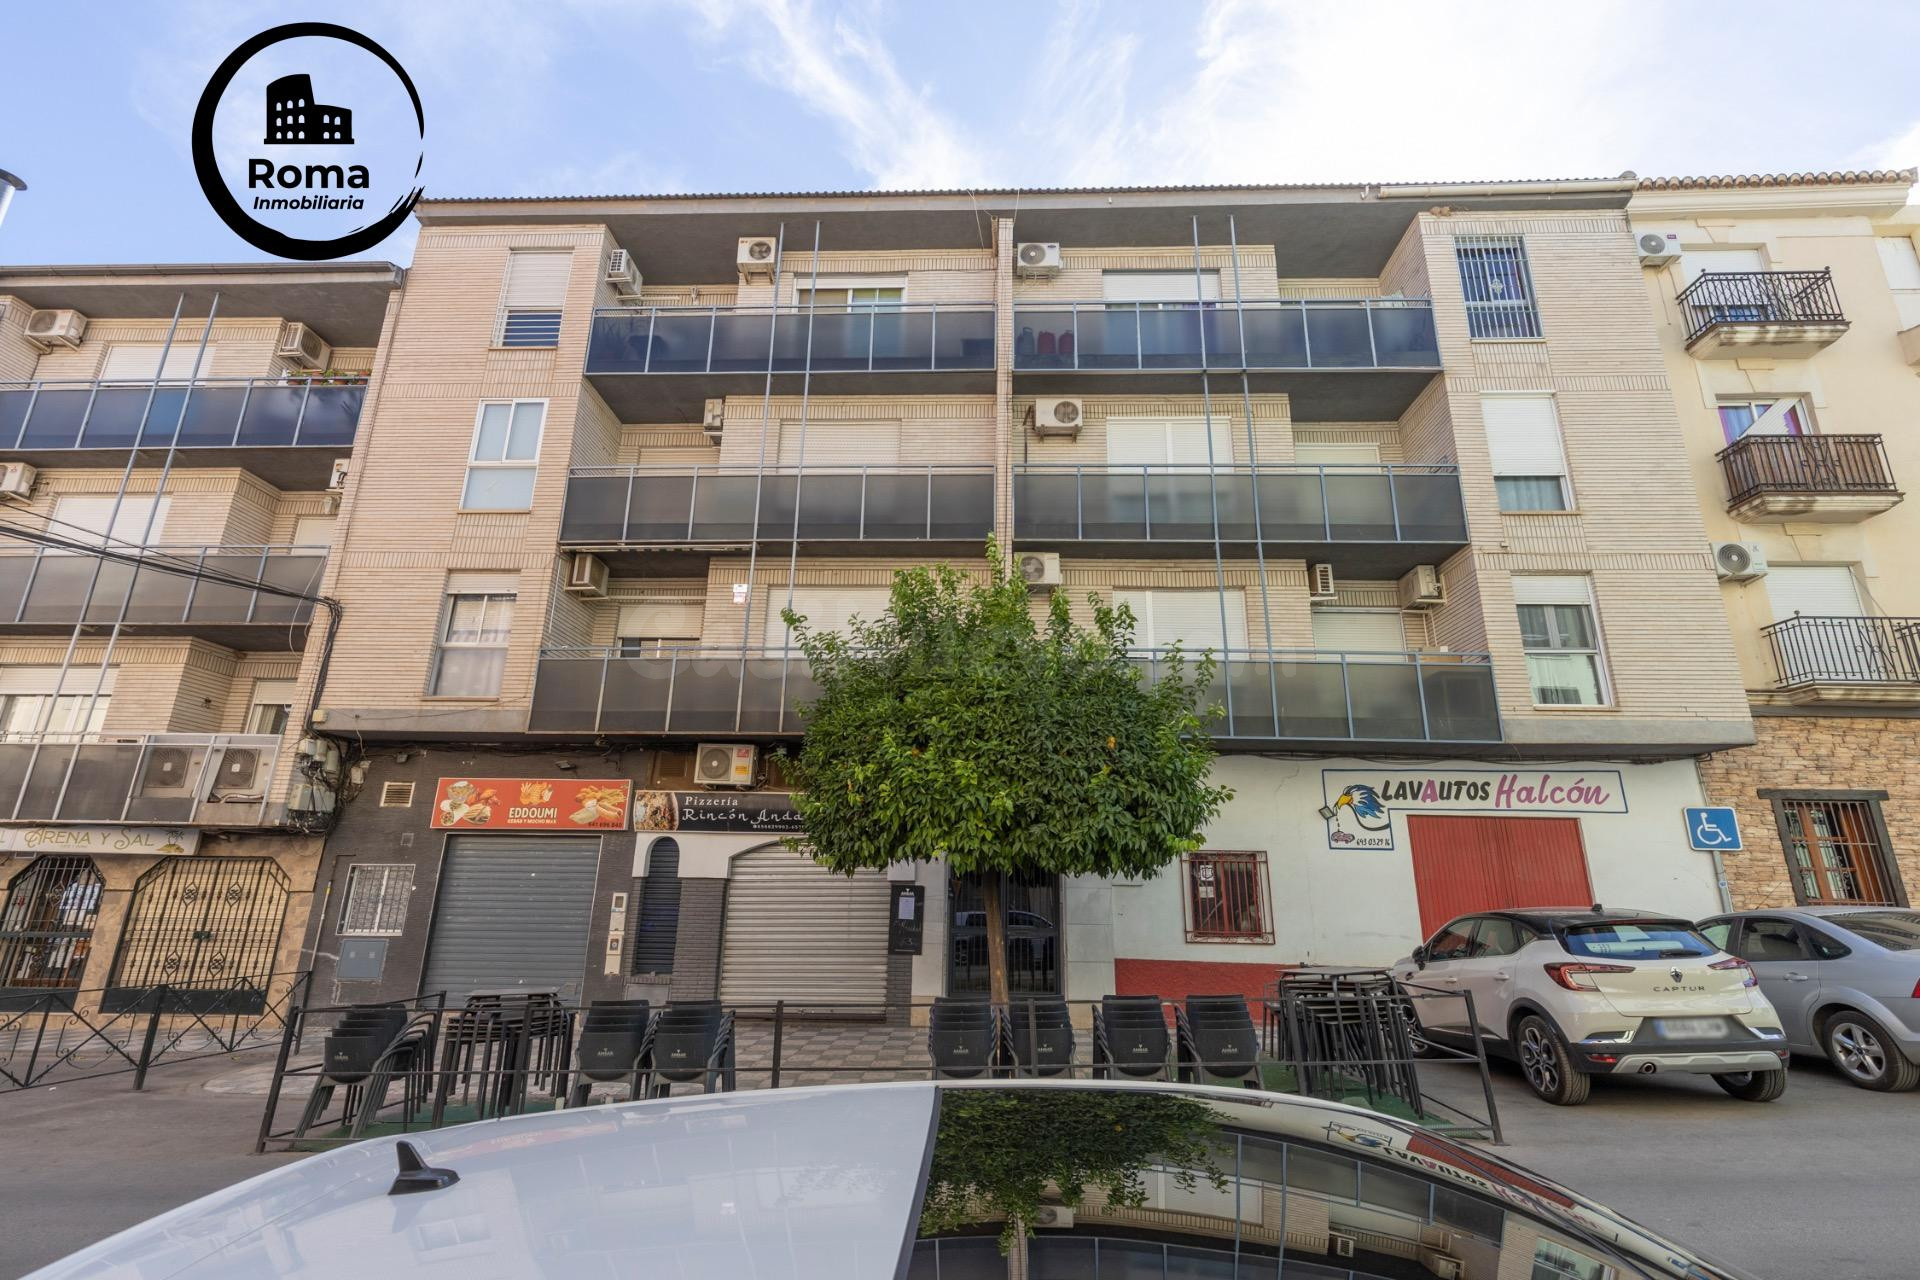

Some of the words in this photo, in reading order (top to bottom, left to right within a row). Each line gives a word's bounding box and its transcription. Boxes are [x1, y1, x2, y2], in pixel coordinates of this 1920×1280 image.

[1381, 779, 1491, 802] LAVAUTOS
[1495, 774, 1610, 808] Halcón
[685, 796, 739, 806] Pizzería
[508, 807, 558, 819] EDDOUMI
[682, 808, 749, 822] Rincón
[750, 808, 804, 825] Anda
[24, 827, 92, 848] ARENA
[100, 832, 112, 845] Y
[113, 827, 155, 850] SAL
